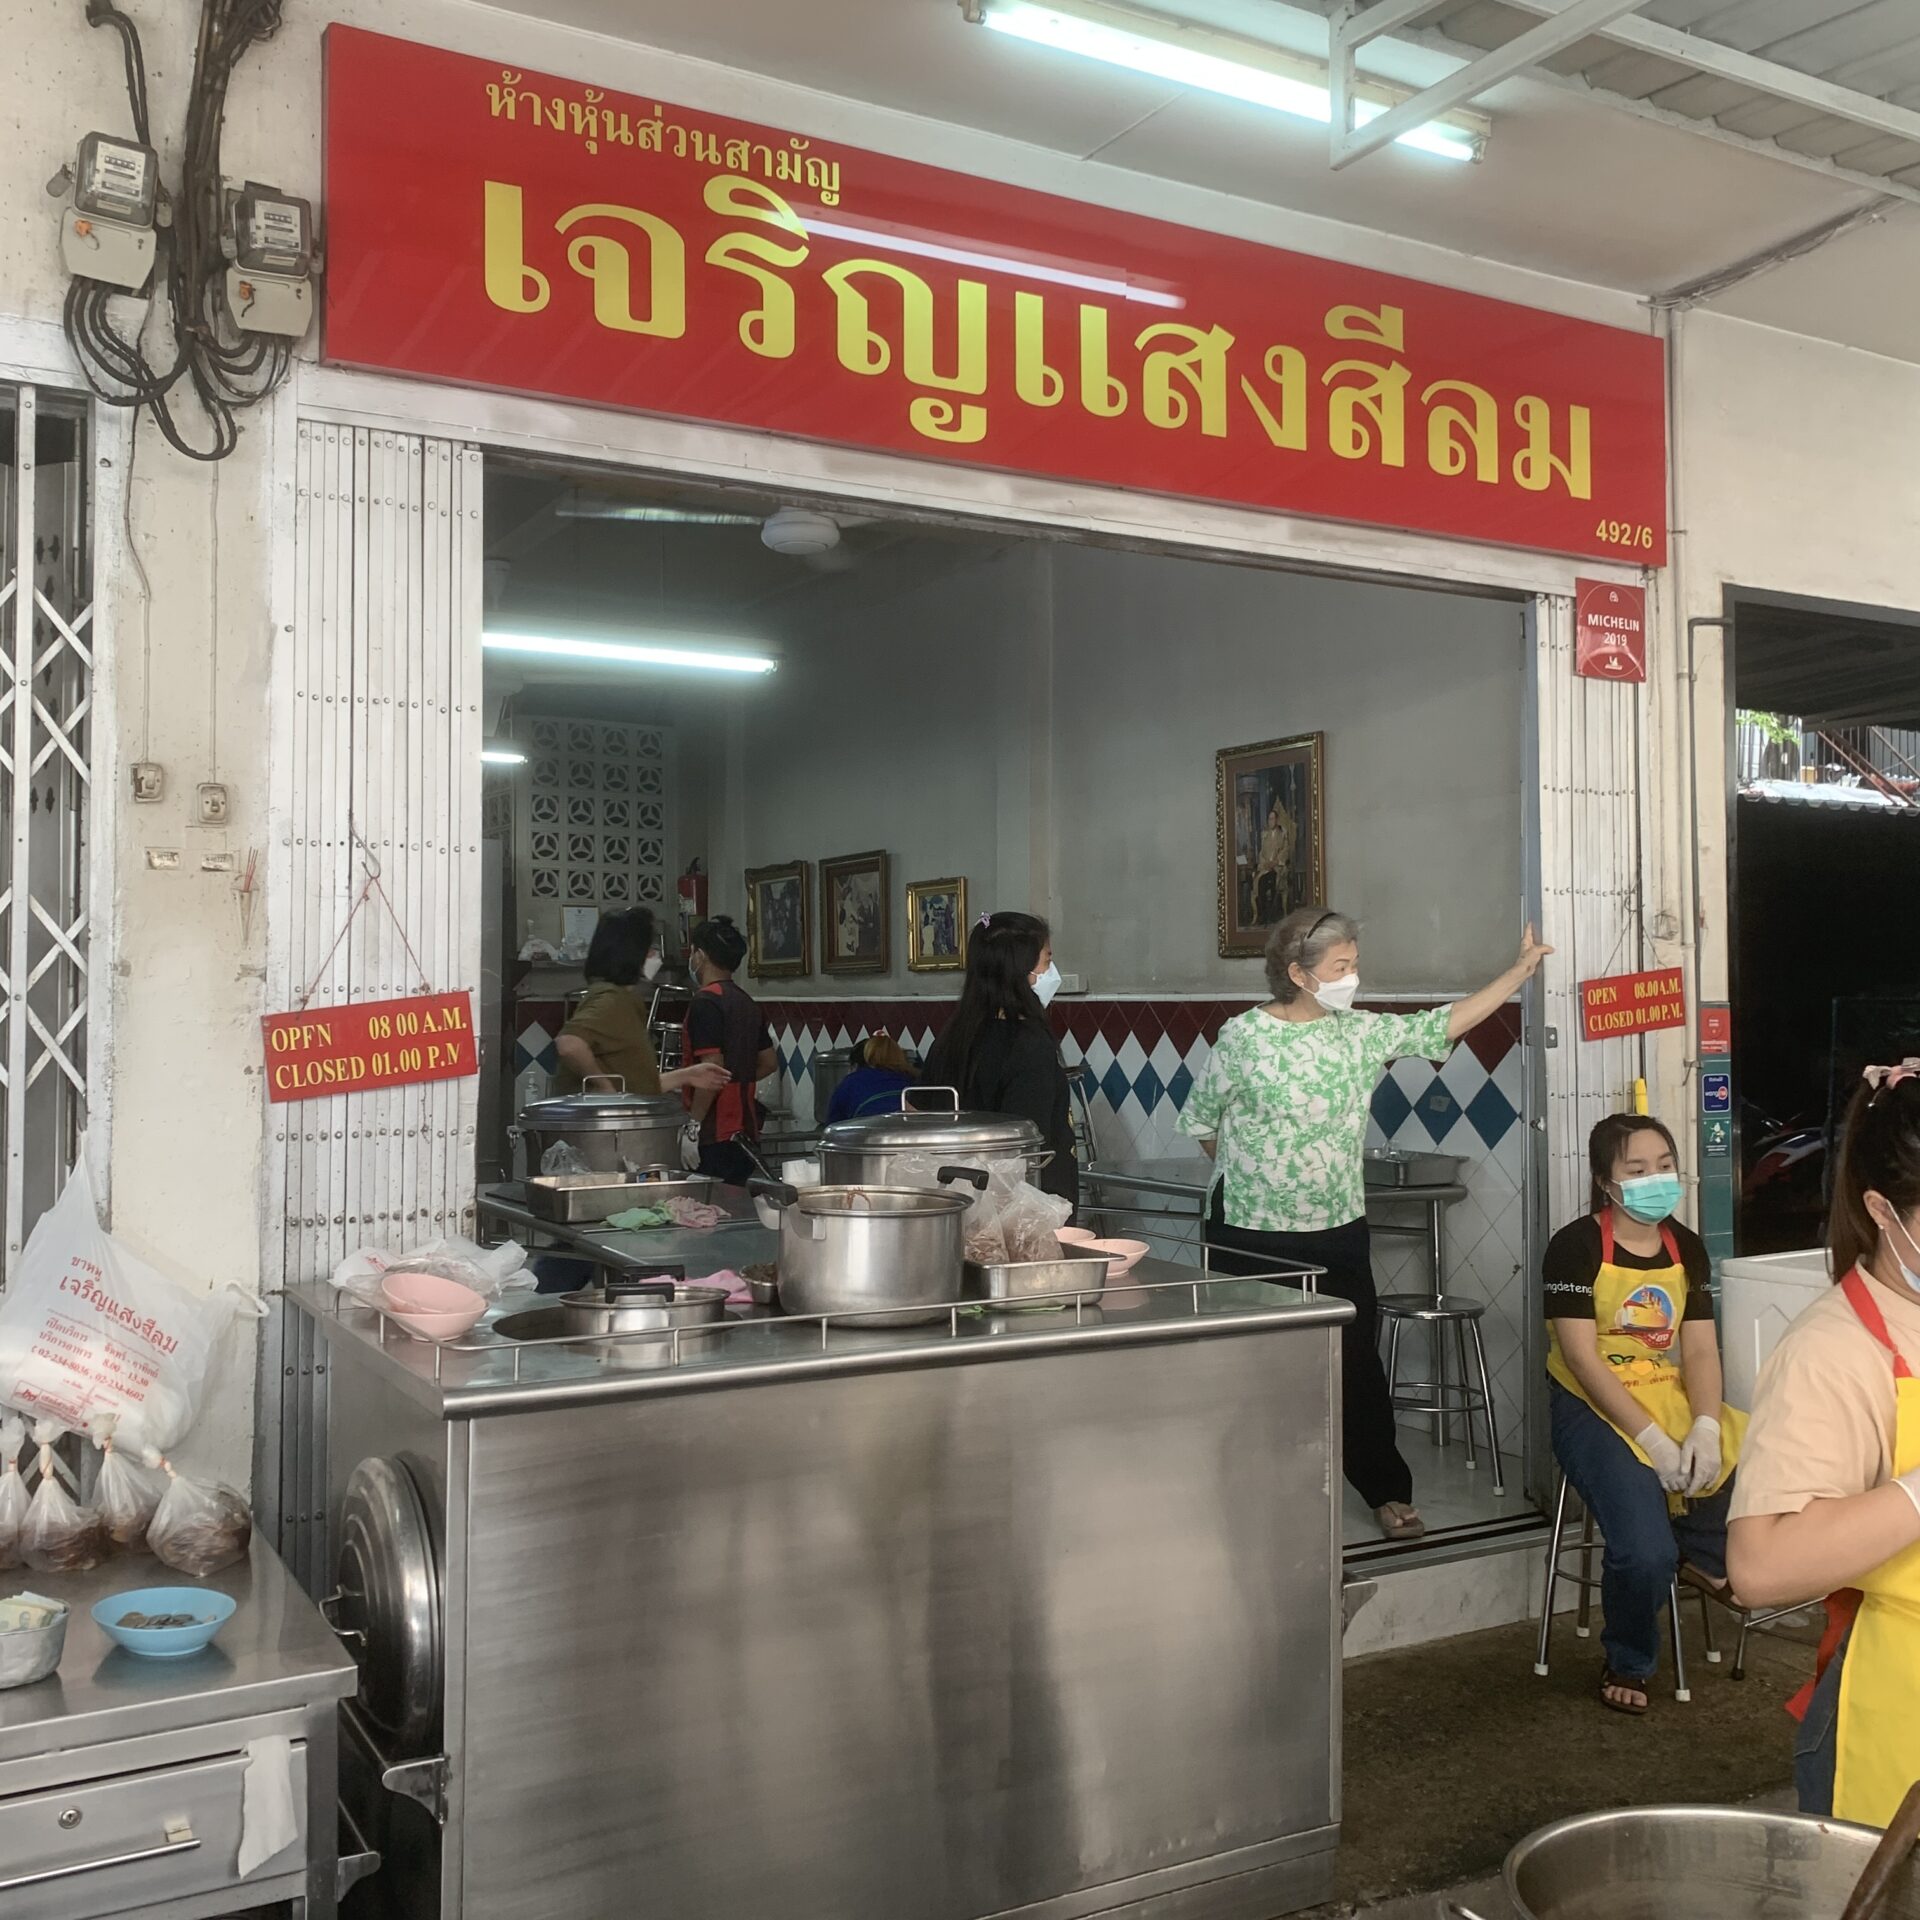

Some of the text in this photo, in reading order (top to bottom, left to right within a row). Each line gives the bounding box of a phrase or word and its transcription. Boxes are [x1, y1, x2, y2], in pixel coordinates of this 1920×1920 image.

[485, 69, 841, 206] ห้างหุ้นส่วนสามัญ
[483, 174, 1593, 501] เจริญแสงสีลม
[1595, 519, 1653, 549] 492/6
[1587, 613, 1640, 632] MICHELIN
[1604, 631, 1628, 647] 2019
[1587, 986, 1617, 1006] OPEN
[1589, 1010, 1634, 1032] CLOSED
[275, 1055, 366, 1090] CLOSED
[371, 1047, 422, 1077] 01.00
[71, 1256, 103, 1282] ขาหมู
[59, 1275, 179, 1355] เจริญแสงสีลม
